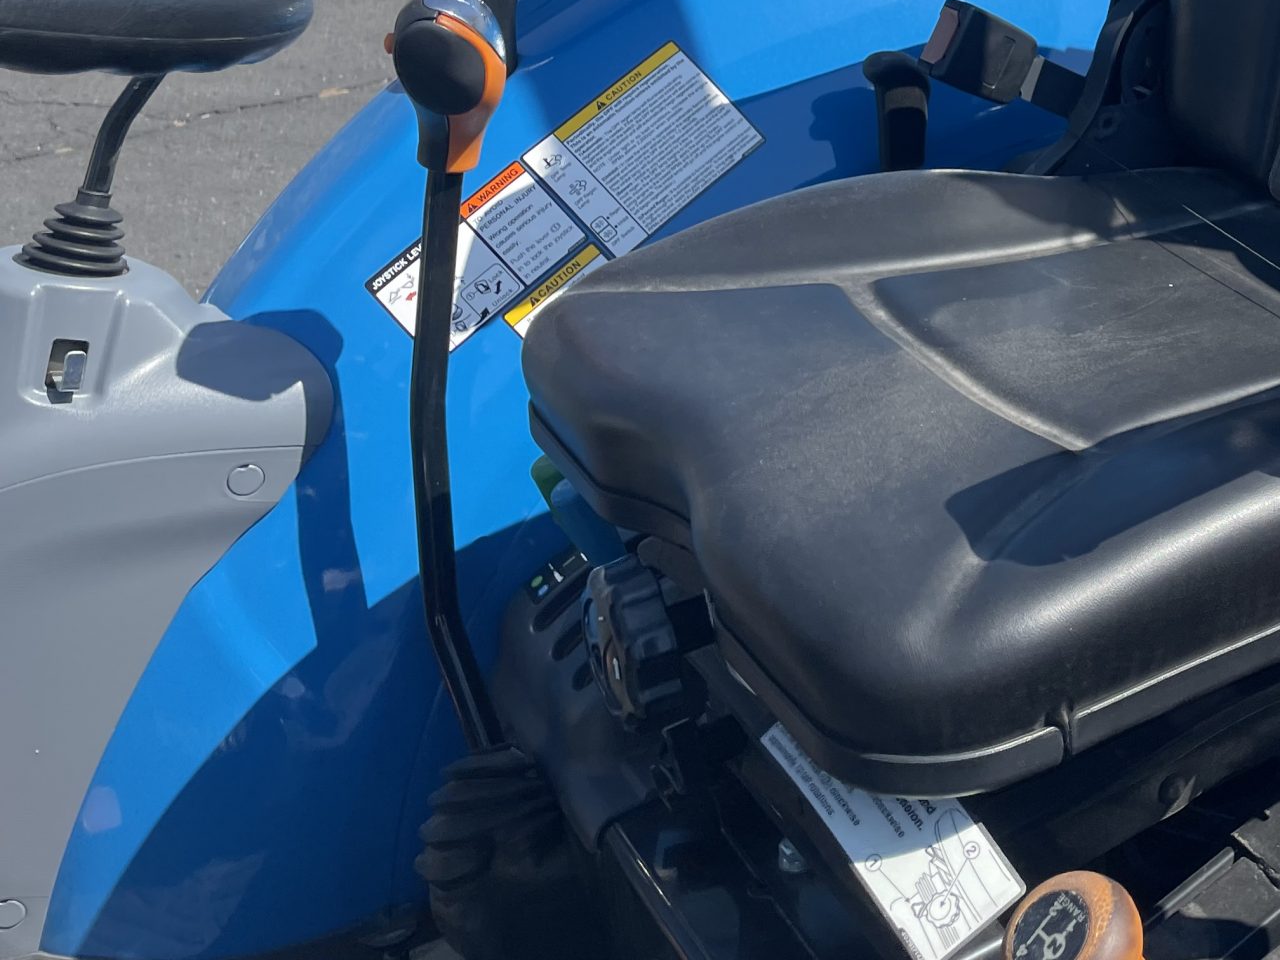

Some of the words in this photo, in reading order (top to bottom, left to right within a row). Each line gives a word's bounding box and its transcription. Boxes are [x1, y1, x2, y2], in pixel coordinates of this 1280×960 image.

[604, 70, 642, 101] CAUTION
[478, 168, 519, 203] WARNING
[478, 202, 515, 232] PERSONAL
[513, 184, 537, 204] INJURY
[487, 224, 508, 241] Wrong
[505, 202, 535, 227] operation
[494, 230, 517, 249] causes
[514, 213, 537, 232] serious
[535, 200, 554, 216] injury
[372, 258, 408, 291] JOYSTICK
[407, 243, 423, 260] LEV
[488, 270, 503, 284] Lock
[538, 259, 581, 298] CAUTION
[492, 288, 513, 307] Unlock
[1057, 893, 1087, 922] RANGE
